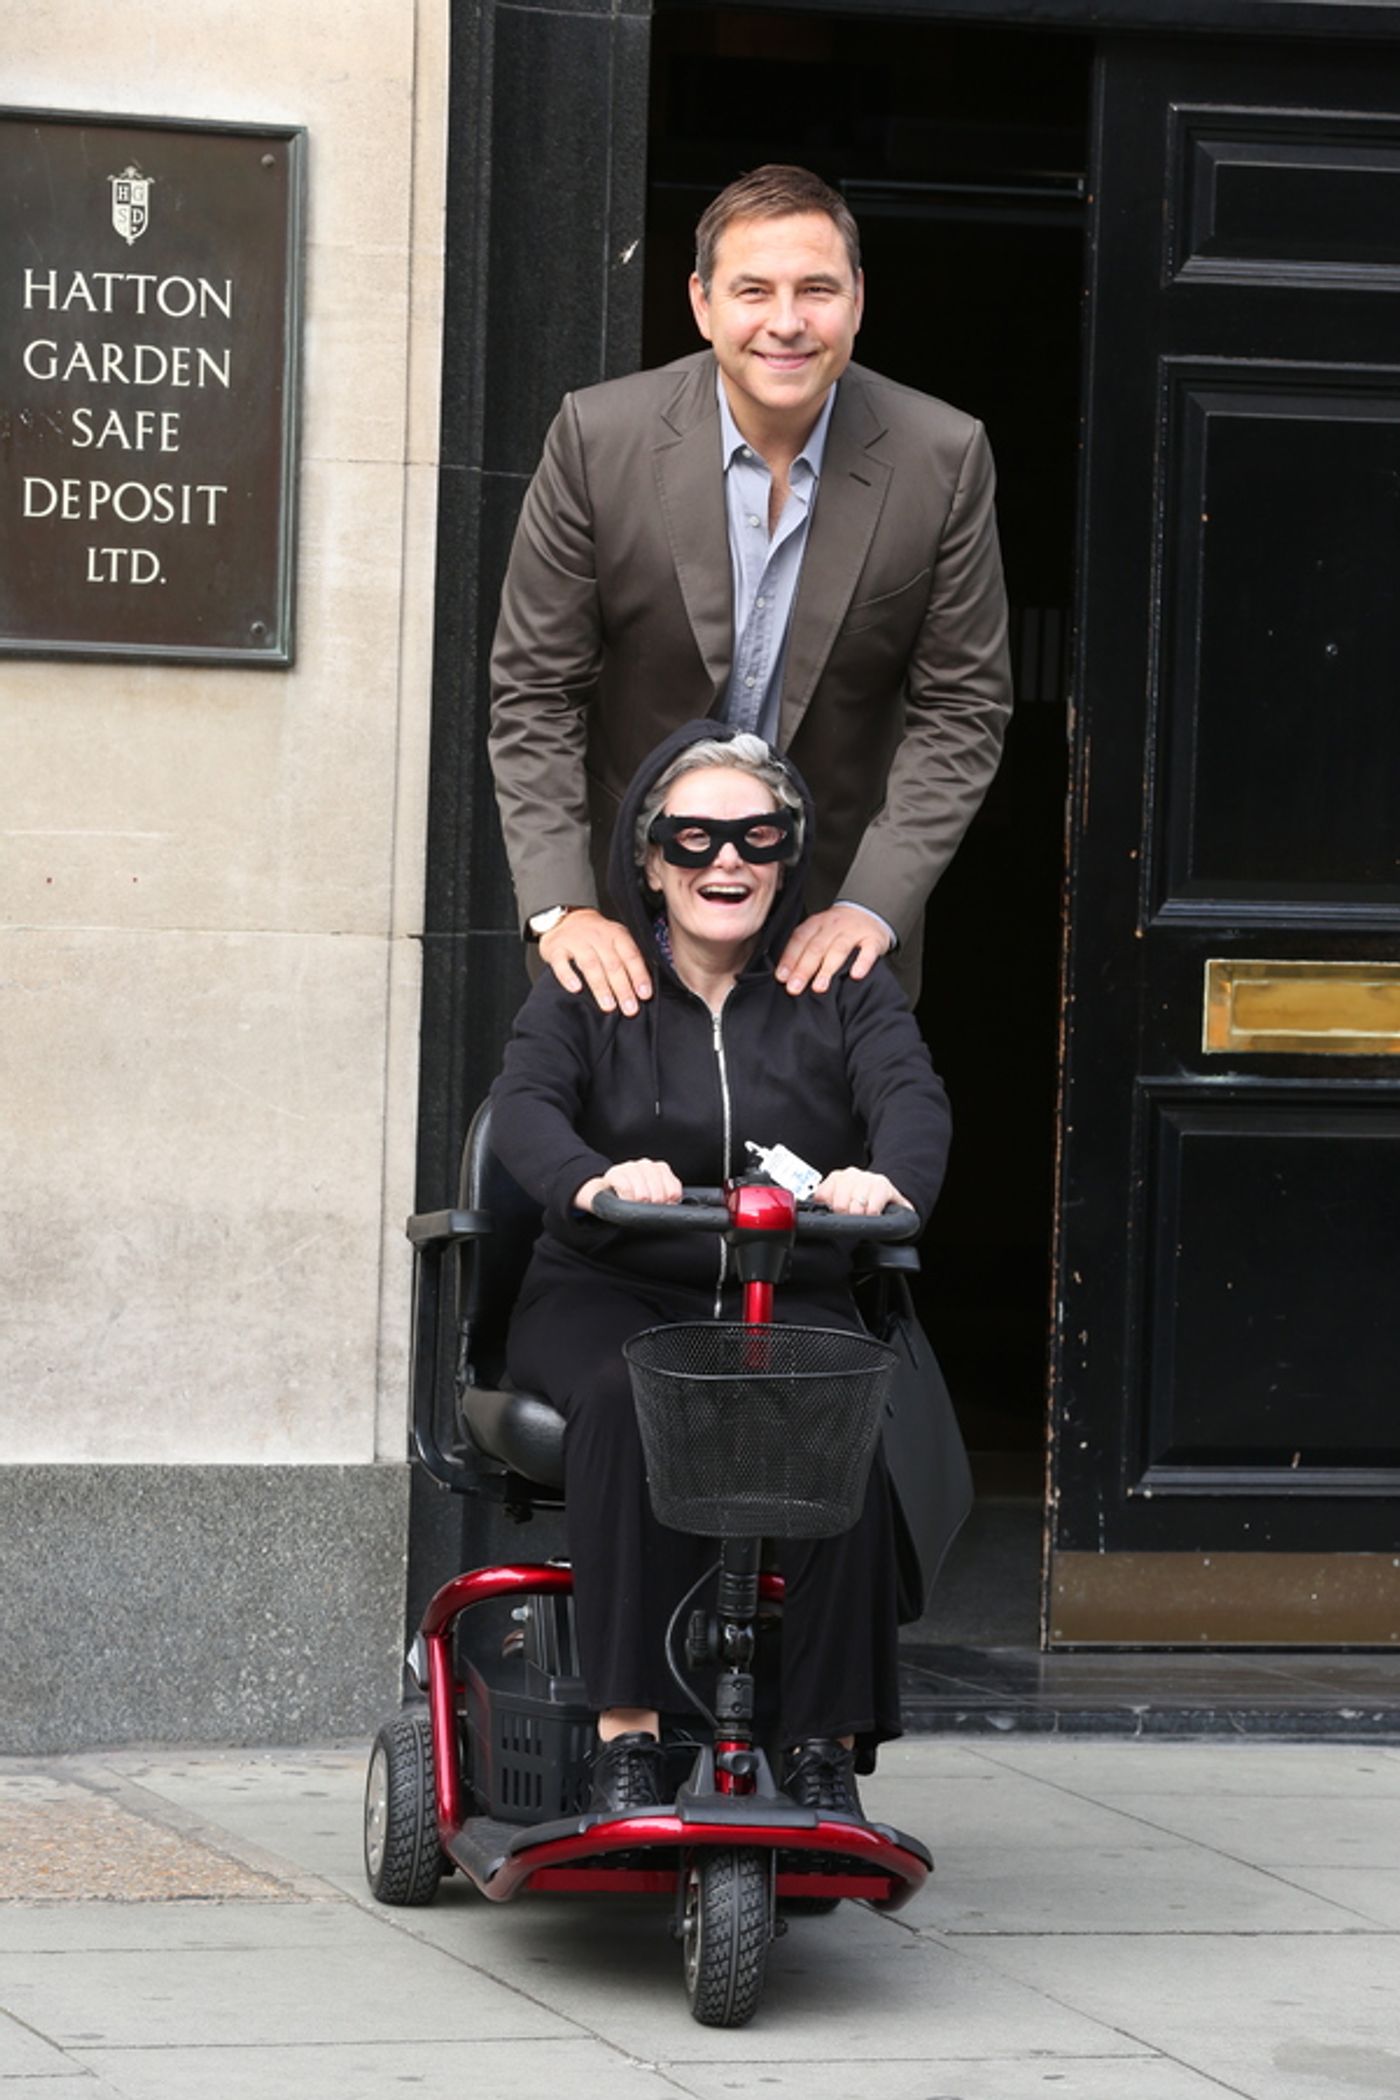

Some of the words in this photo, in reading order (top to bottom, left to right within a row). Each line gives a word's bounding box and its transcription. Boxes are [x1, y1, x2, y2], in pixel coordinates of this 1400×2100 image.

[23, 268, 232, 319] HATTON
[23, 340, 231, 389] GARDEN
[71, 408, 180, 452] SAFE
[23, 477, 228, 525] DEPOSIT
[87, 548, 166, 584] LTD.
